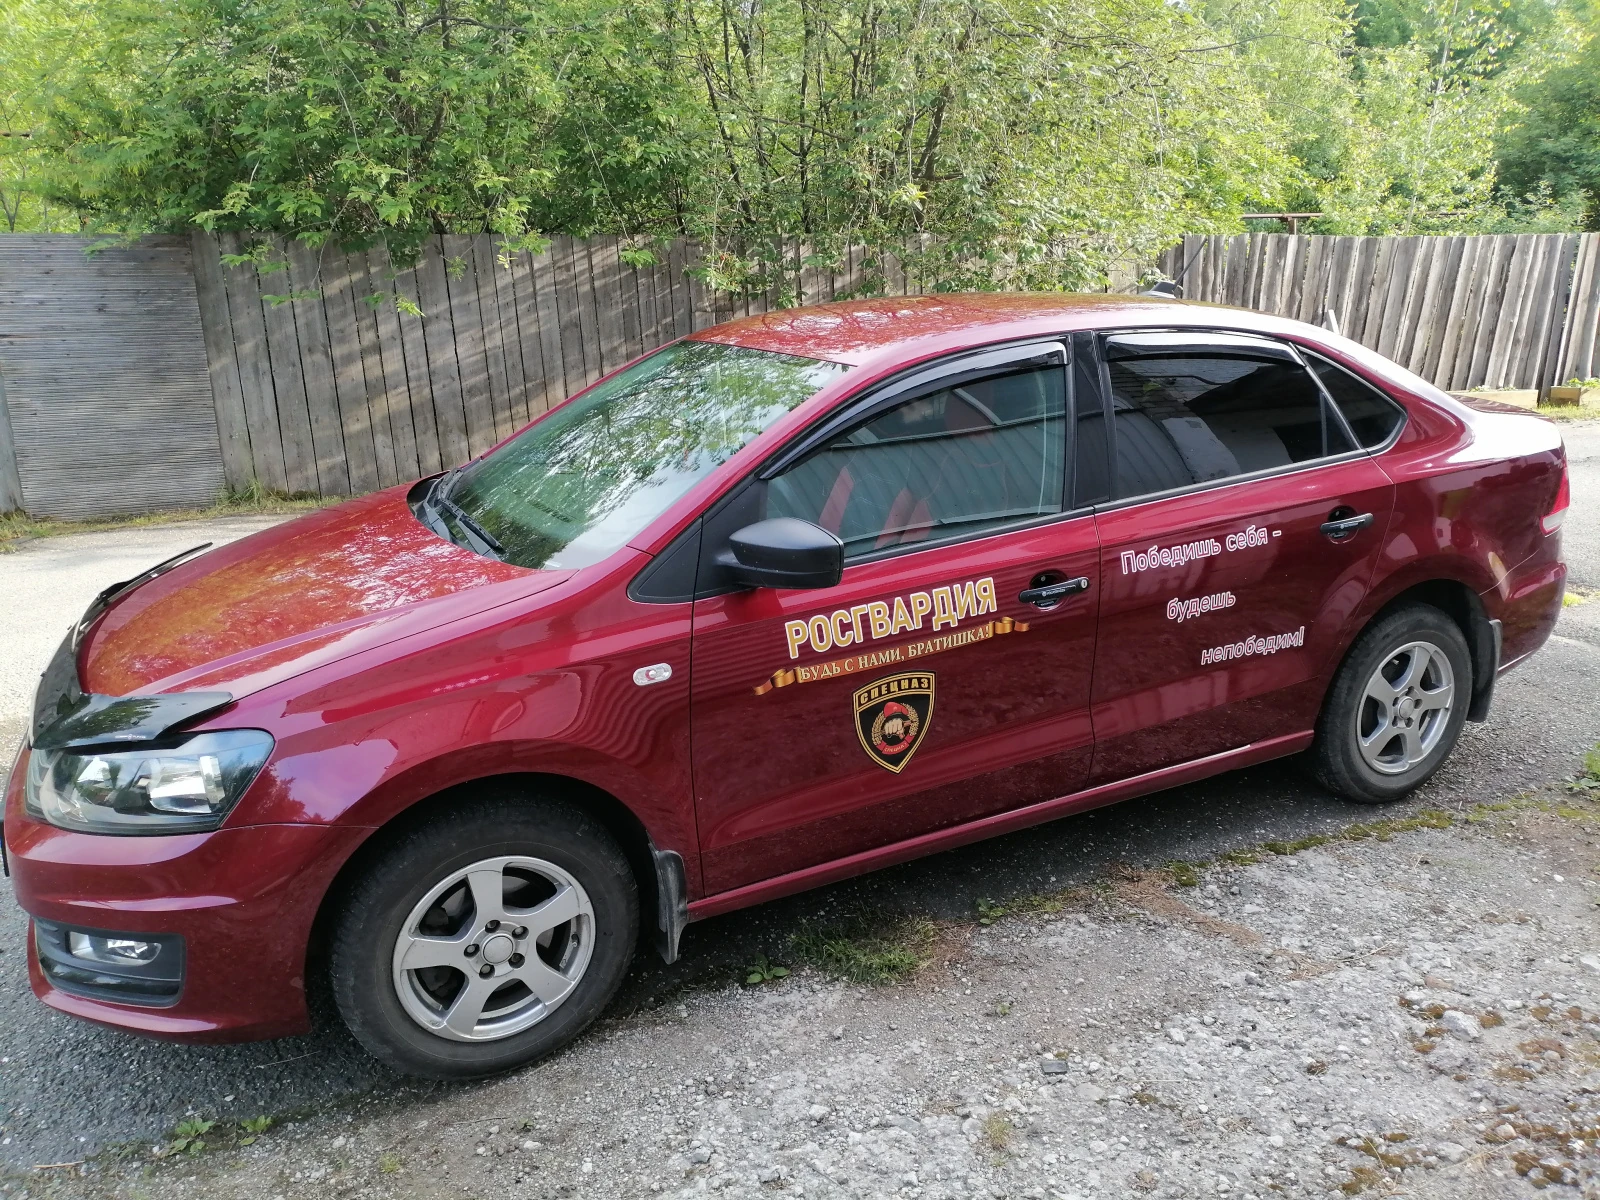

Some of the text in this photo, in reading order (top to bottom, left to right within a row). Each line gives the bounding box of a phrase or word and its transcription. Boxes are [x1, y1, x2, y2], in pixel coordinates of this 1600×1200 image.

[1121, 538, 1221, 574] Победишь
[1226, 525, 1268, 551] себя
[785, 577, 998, 659] РОСГВАРДИЯ
[1167, 591, 1236, 623] будешь
[800, 625, 990, 681] БУДЬ С НАМИ, БРАТИШКА!
[1200, 626, 1305, 665] непобедим!
[860, 678, 929, 704] СПЕЦНАЗ
